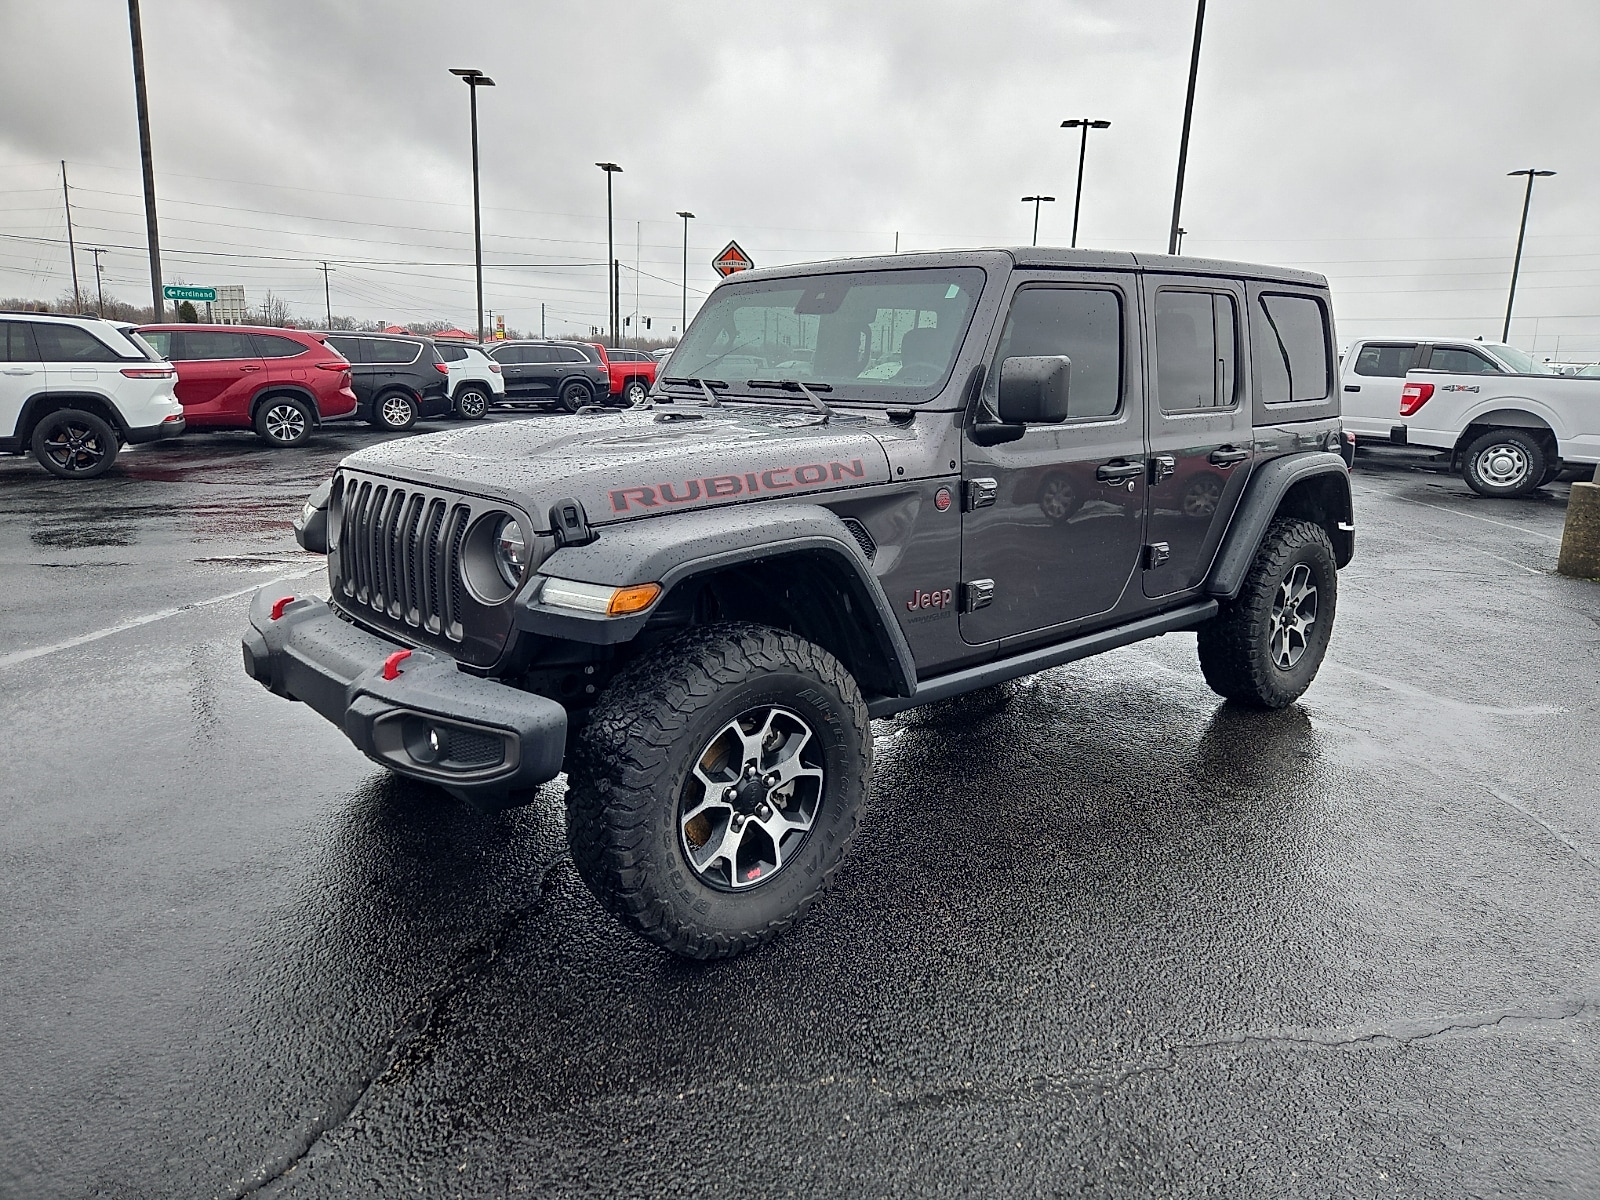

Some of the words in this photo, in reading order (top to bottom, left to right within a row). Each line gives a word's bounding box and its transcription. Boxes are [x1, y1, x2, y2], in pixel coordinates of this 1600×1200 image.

[176, 290, 213, 298] Ferdinand
[608, 459, 865, 512] RUBICON
[906, 588, 952, 612] Jeep
